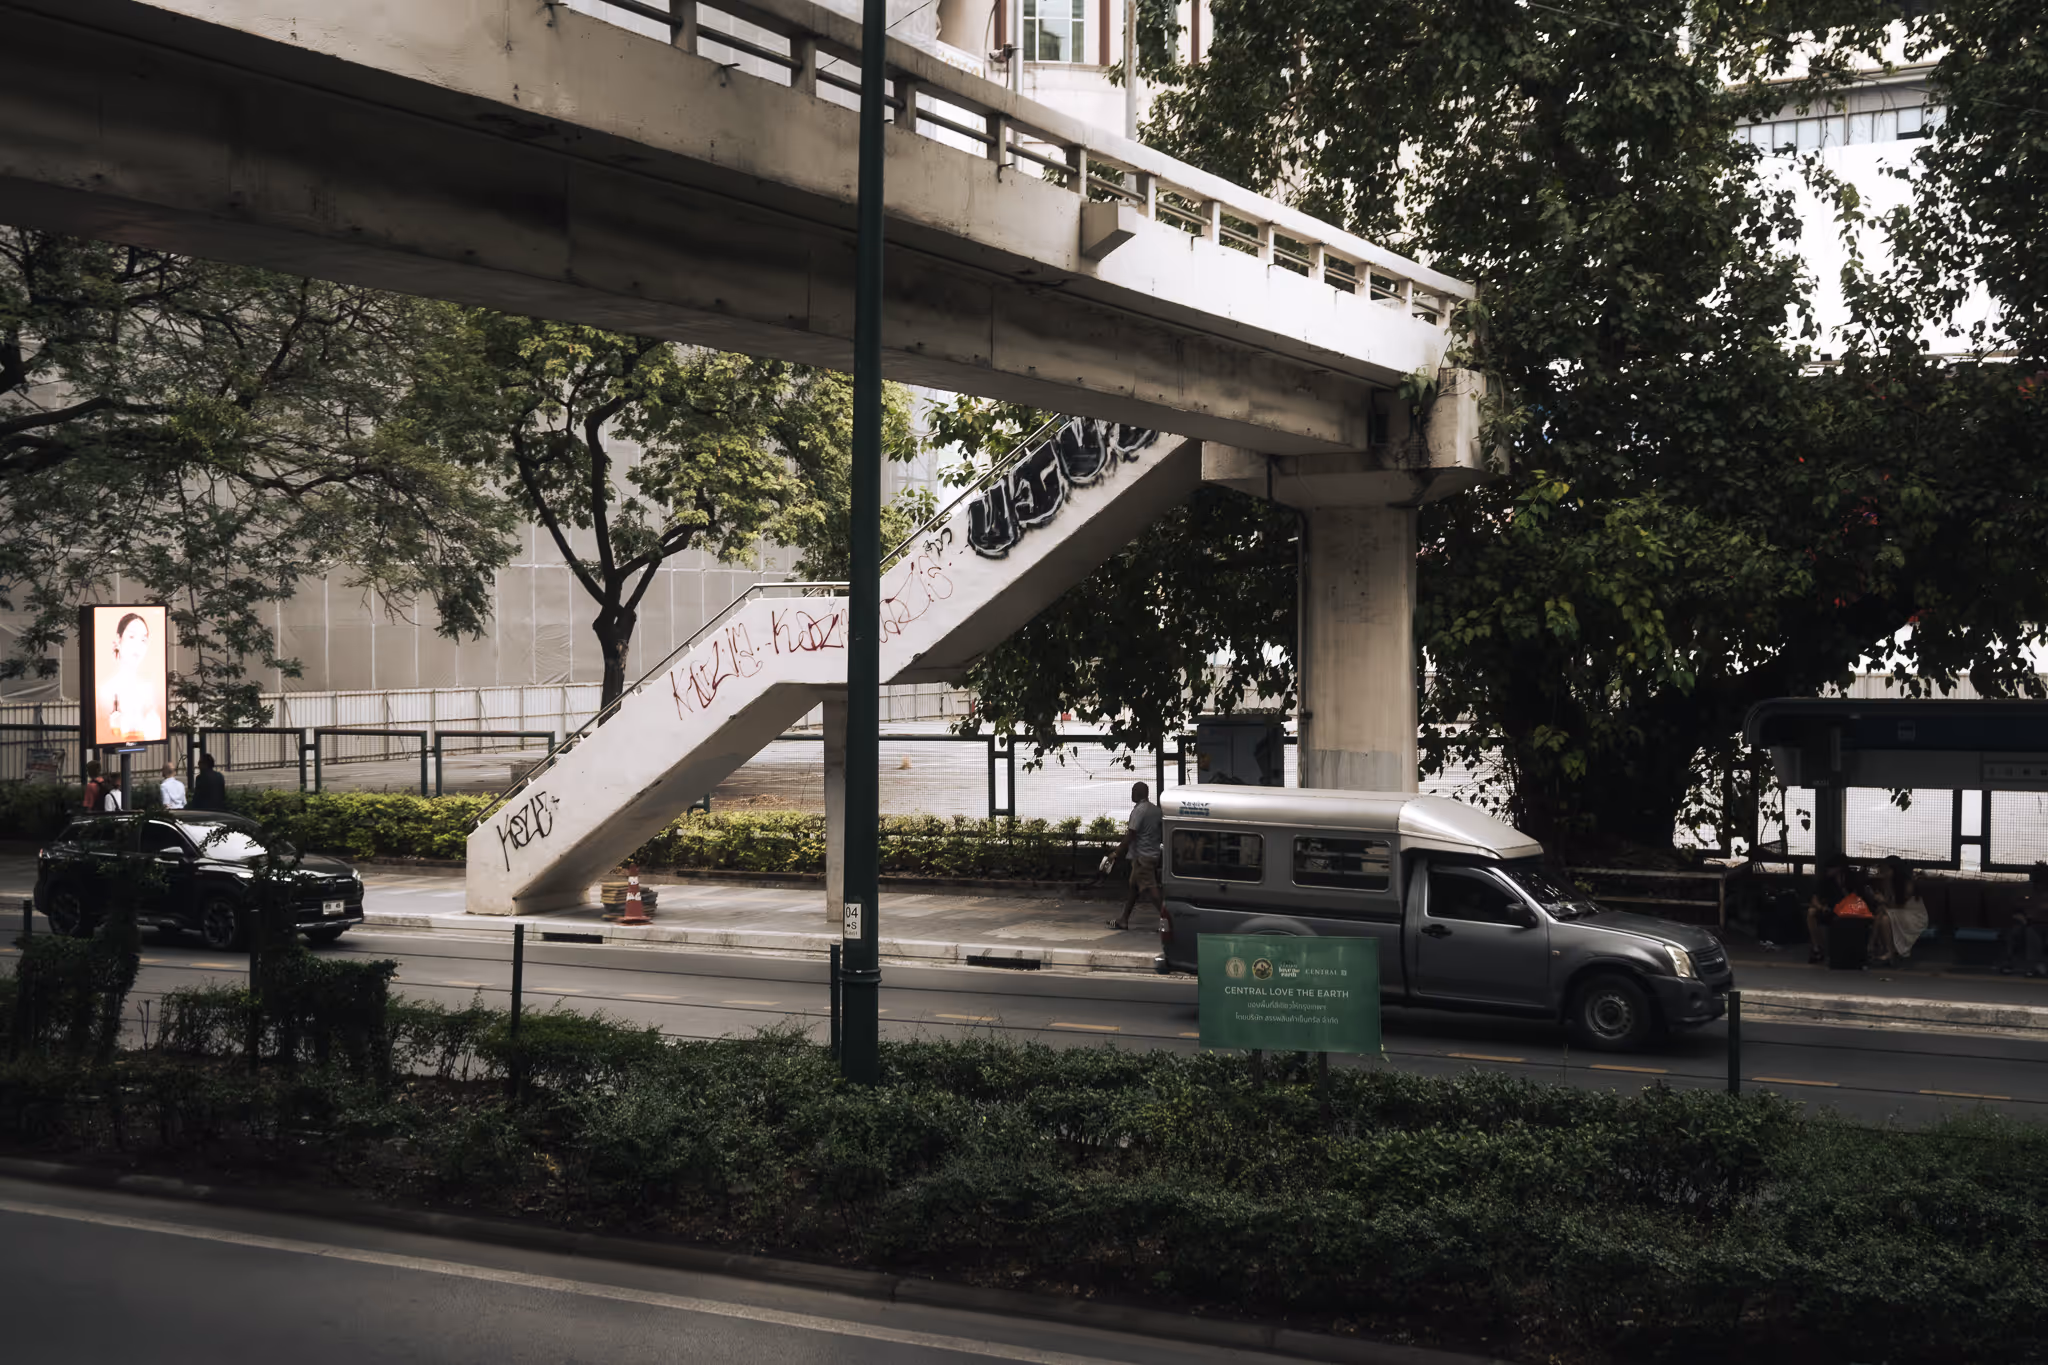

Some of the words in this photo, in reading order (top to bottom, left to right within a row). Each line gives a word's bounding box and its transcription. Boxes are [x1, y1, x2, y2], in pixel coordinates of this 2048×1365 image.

[845, 906, 859, 919] 04
[1305, 968, 1338, 976] CENTRAL
[1224, 986, 1267, 996] CENTRAL
[1269, 987, 1294, 997] LOVE
[1296, 988, 1315, 998] THE
[1317, 989, 1349, 999] EARTH
